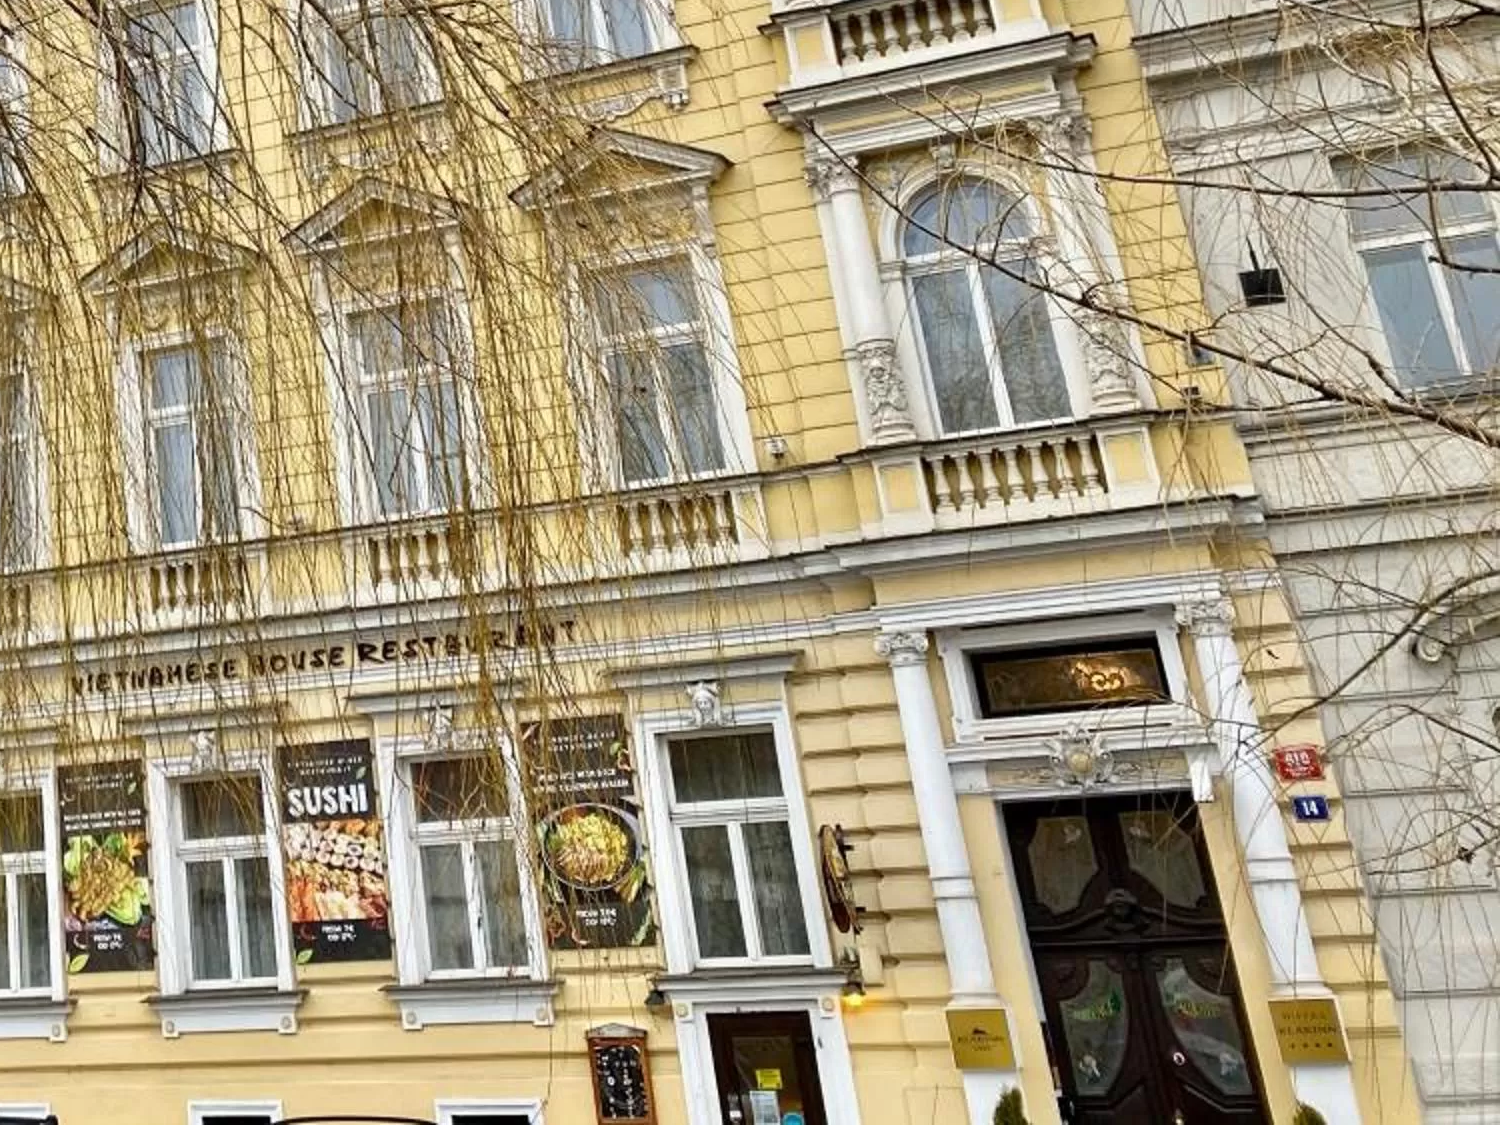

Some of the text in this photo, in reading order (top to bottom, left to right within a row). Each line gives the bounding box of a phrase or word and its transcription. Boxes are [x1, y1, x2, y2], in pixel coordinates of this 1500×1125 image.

[71, 659, 237, 696] VIETNAMESE
[250, 646, 346, 676] HOUSE
[287, 782, 369, 817] SUSHI
[1302, 800, 1319, 816] 14
